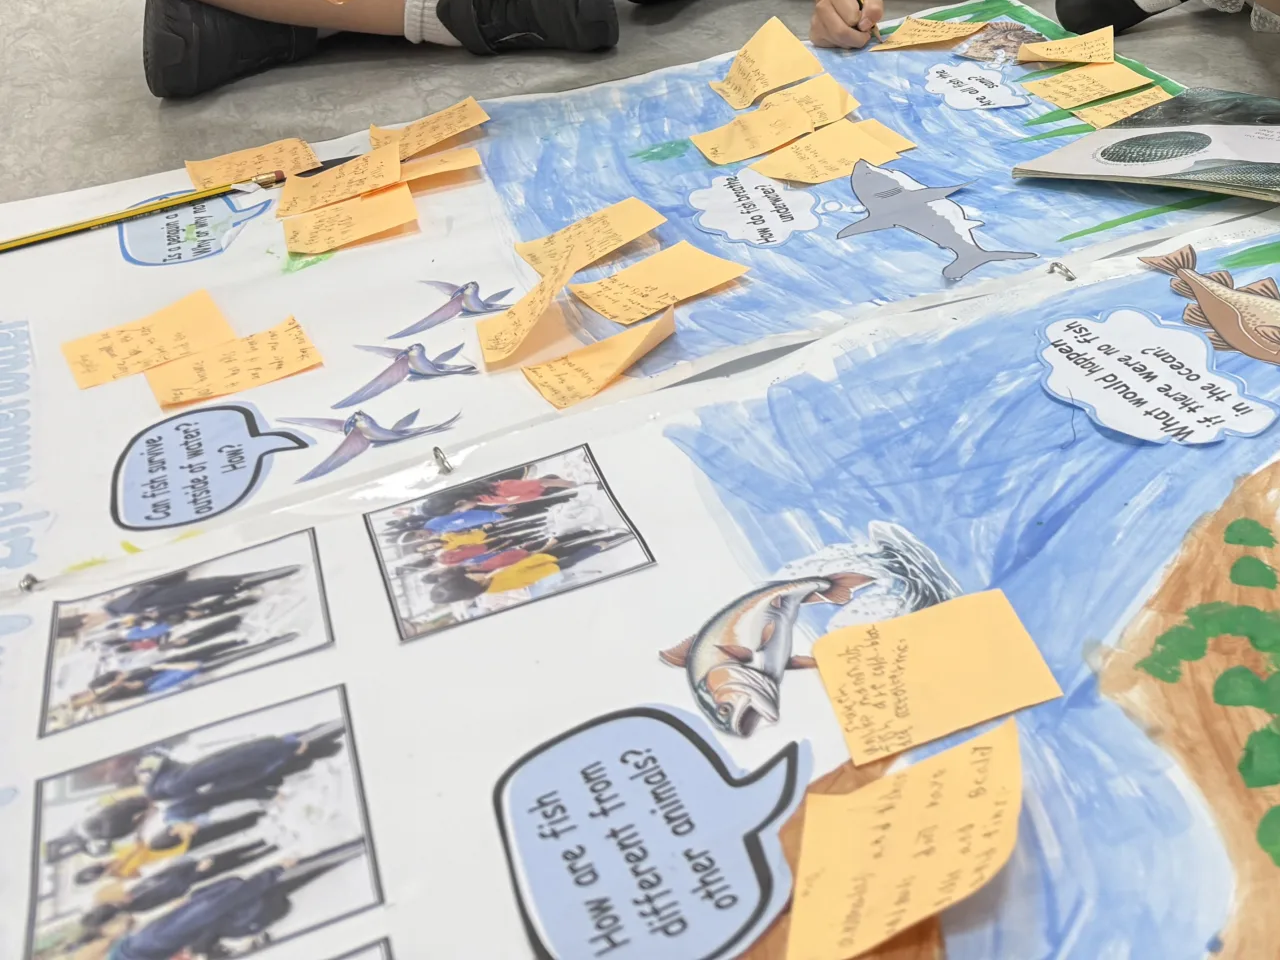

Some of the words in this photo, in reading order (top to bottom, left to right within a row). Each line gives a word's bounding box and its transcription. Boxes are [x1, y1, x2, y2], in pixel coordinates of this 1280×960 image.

[935, 69, 953, 79] the
[946, 77, 968, 89] fish
[967, 75, 999, 89] same?
[960, 86, 980, 95] all
[975, 95, 996, 107] Are
[722, 176, 751, 203] breathe
[736, 202, 761, 215] fish
[754, 184, 795, 223] underwater?
[160, 219, 187, 246] penguin
[746, 214, 766, 225] do
[191, 237, 216, 257] Why
[756, 227, 777, 245] How
[162, 252, 183, 263] Is
[1062, 319, 1100, 345] fish
[1049, 337, 1104, 382] happen
[1096, 343, 1120, 357] no
[1116, 354, 1158, 383] were
[1140, 345, 1202, 383] ocean?
[1099, 372, 1149, 409] would
[1156, 383, 1205, 414] there
[1200, 381, 1234, 403] the
[1196, 415, 1226, 428] if
[1232, 401, 1254, 418] in
[1143, 406, 1195, 442] What
[174, 421, 205, 460] water?
[140, 435, 168, 474] survive
[179, 460, 203, 474] of
[216, 443, 247, 475] How?
[141, 473, 171, 499] fish
[182, 475, 214, 515] outside
[144, 497, 171, 521] Can
[579, 759, 627, 820] from
[618, 747, 697, 837] animals?
[527, 789, 579, 842] fish
[561, 843, 600, 887] are
[682, 846, 739, 911] other
[604, 822, 690, 938] different
[584, 895, 631, 959] How
